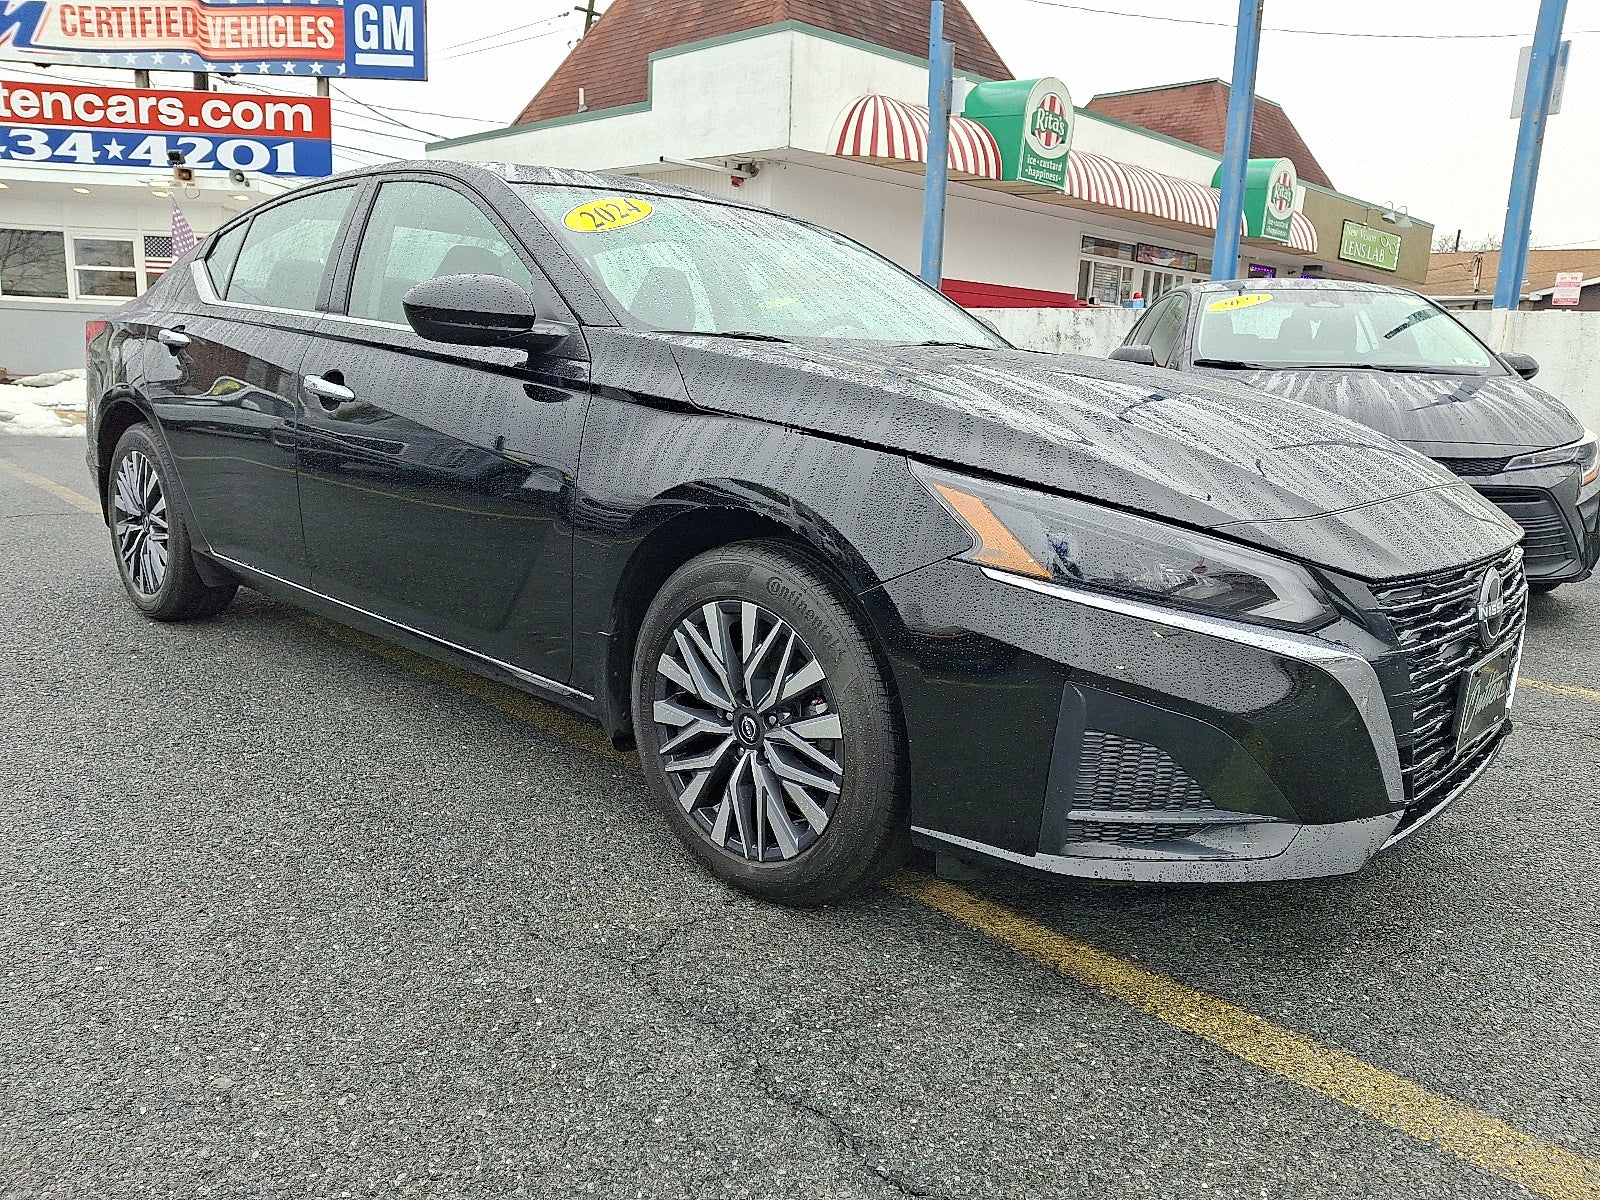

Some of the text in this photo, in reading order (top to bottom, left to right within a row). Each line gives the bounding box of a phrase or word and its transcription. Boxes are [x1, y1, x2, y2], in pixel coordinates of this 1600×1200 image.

[59, 4, 198, 38] CERTIFIED
[206, 15, 335, 50] VEHICLES
[354, 3, 414, 51] GM
[1036, 107, 1065, 136] Rita's
[579, 198, 641, 228] 2024
[1343, 239, 1385, 263] LENS LAB
[765, 576, 839, 649] Continental
